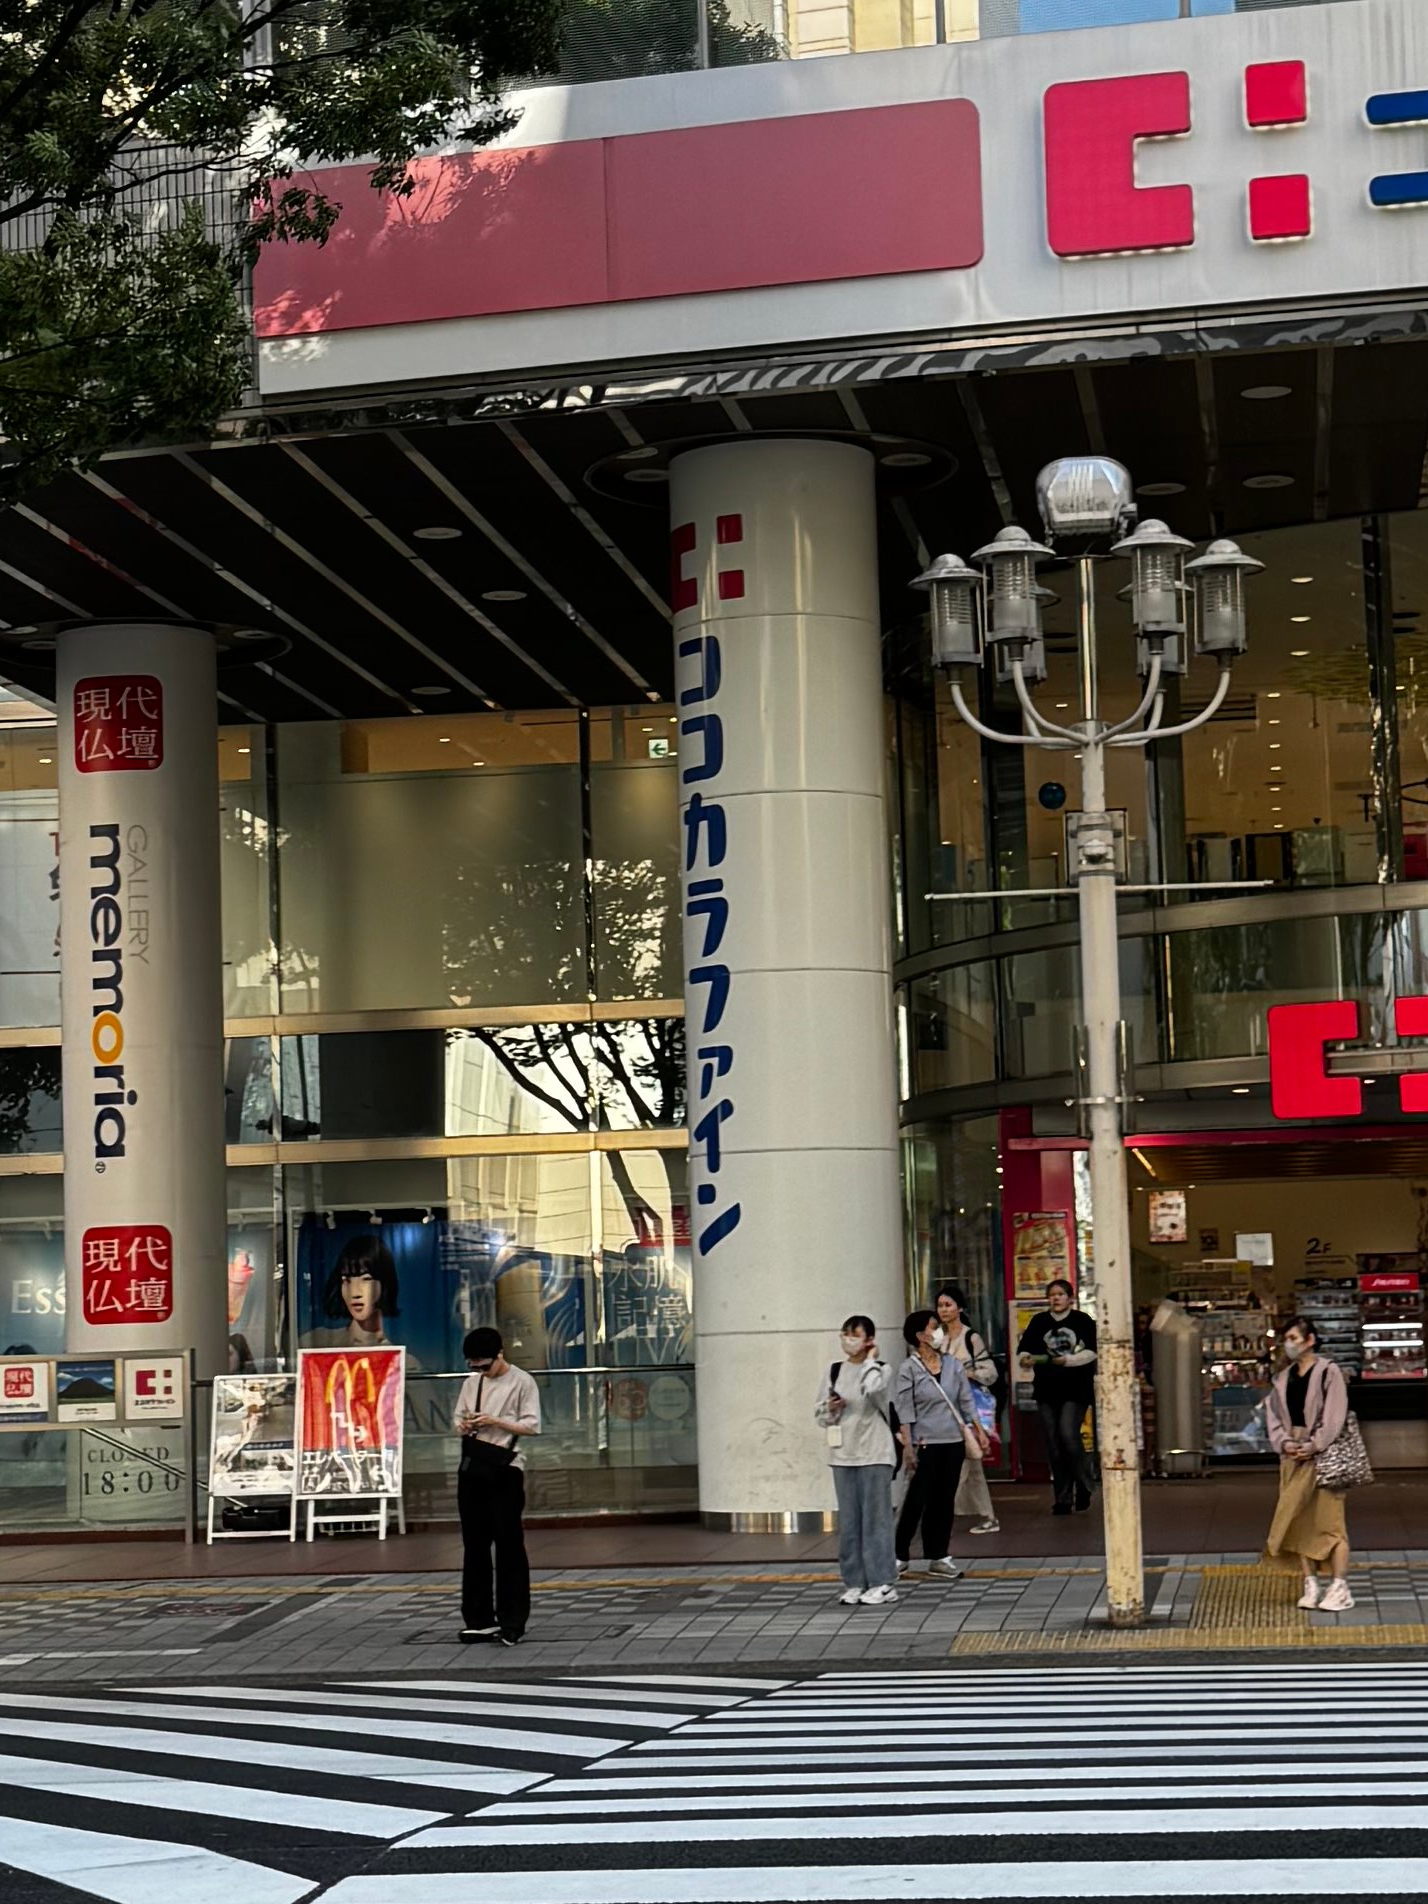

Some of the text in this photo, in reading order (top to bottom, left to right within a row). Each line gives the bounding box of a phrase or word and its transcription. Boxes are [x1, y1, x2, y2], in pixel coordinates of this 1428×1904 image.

[126, 824, 150, 965] GALLERY
[679, 635, 741, 1257] ココカラファイン
[90, 823, 138, 1159] memoria
[85, 1236, 169, 1274] 現代
[85, 1277, 169, 1314] 仏壇
[84, 1470, 180, 1496] 18:00
